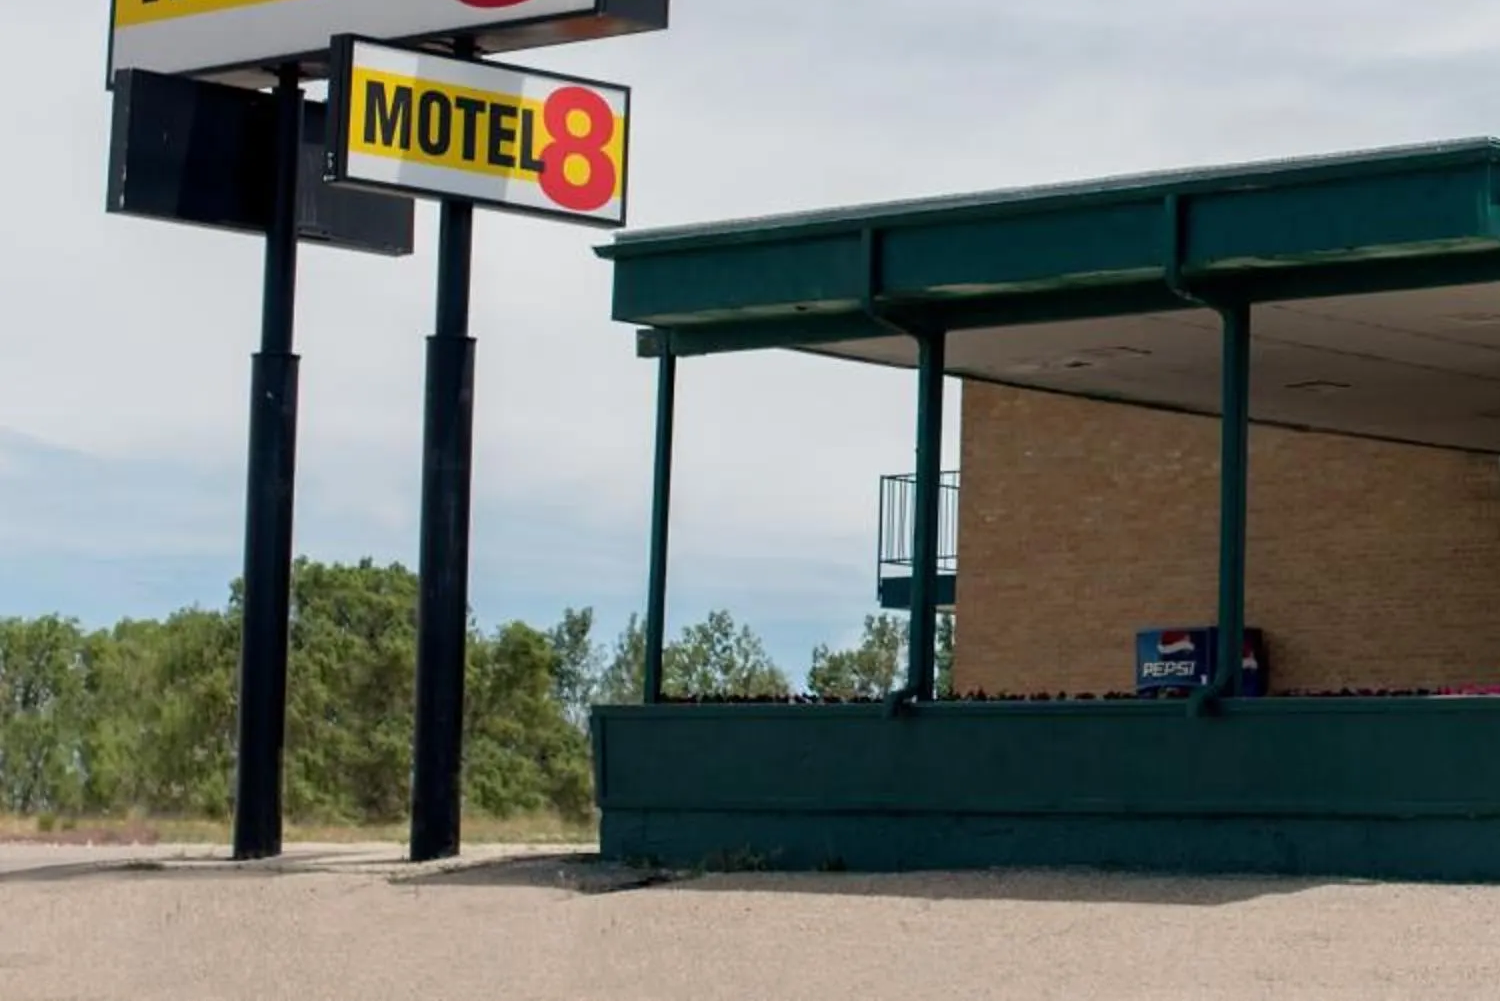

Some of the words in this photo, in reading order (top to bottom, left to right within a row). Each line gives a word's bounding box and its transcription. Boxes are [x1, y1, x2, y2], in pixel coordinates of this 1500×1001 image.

[363, 80, 545, 173] MOTEL
[538, 86, 617, 212] 8
[1142, 660, 1196, 678] PEPSI
